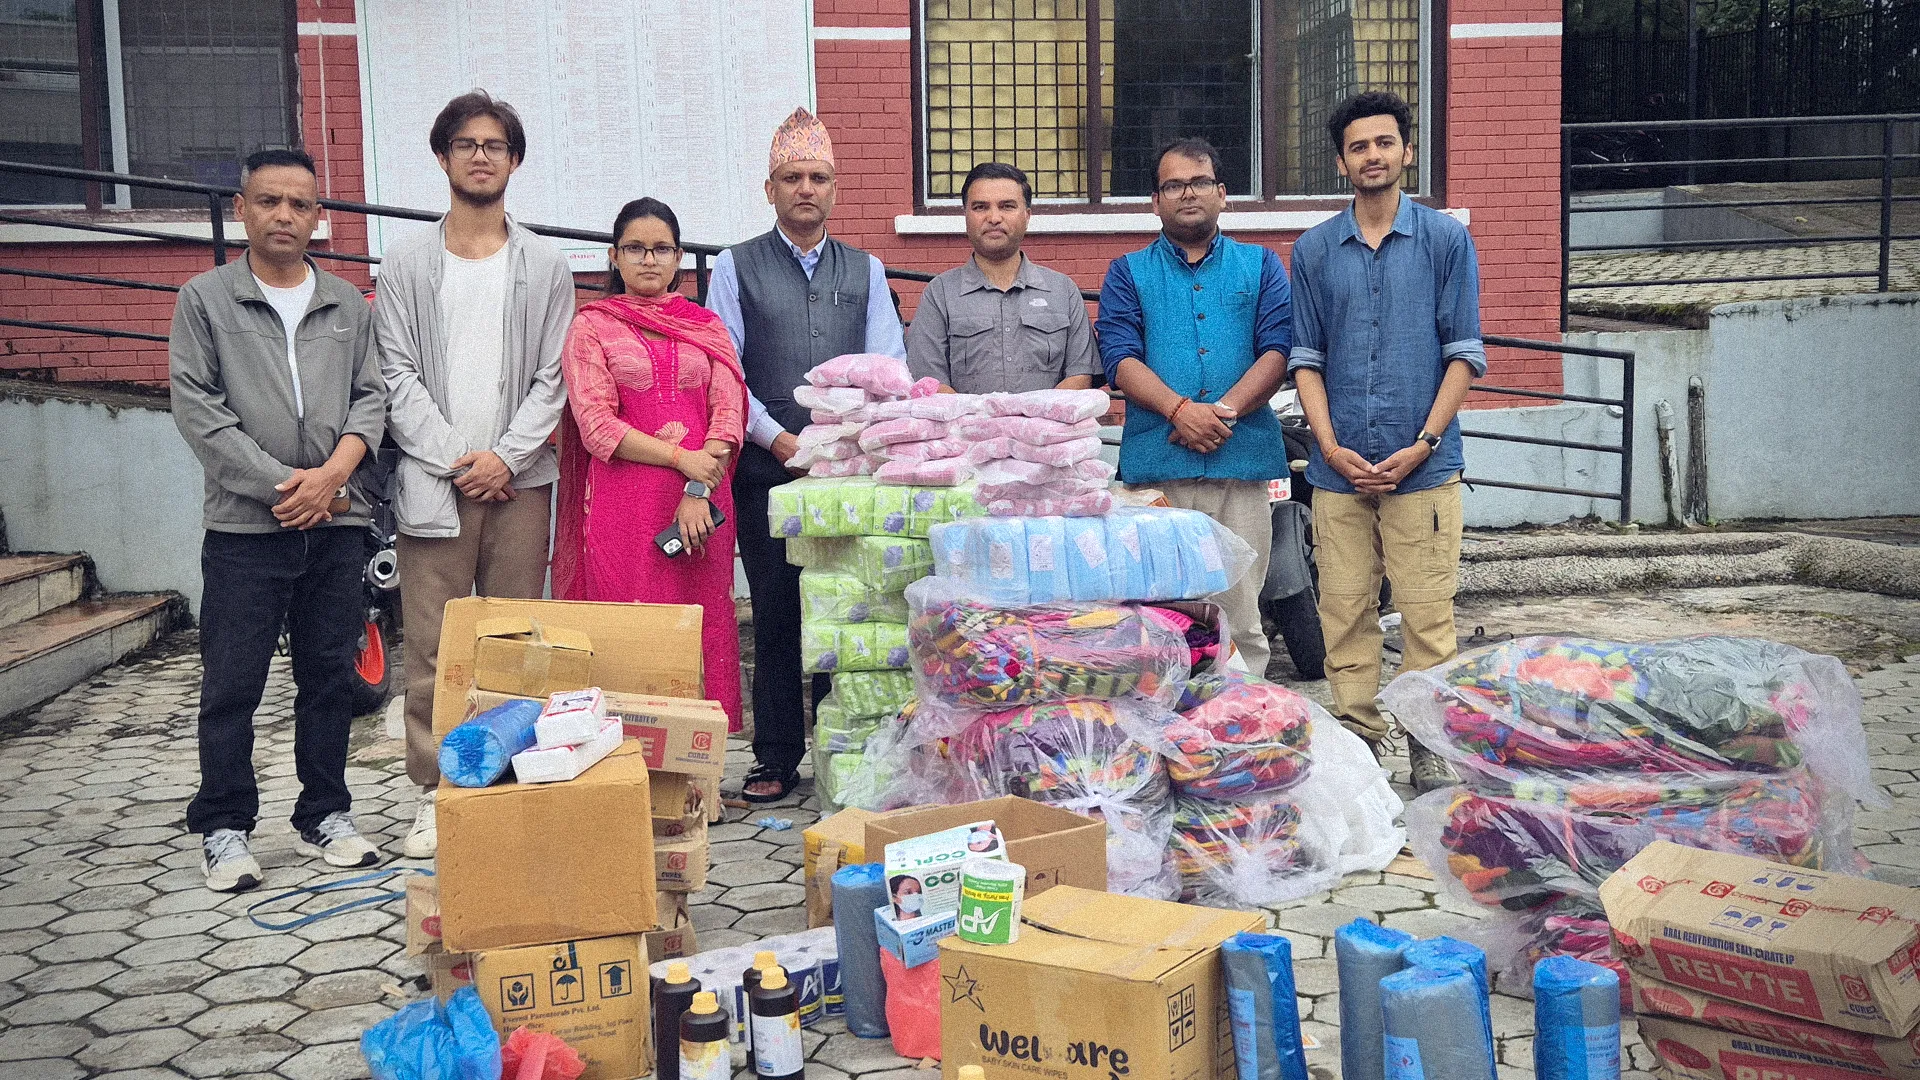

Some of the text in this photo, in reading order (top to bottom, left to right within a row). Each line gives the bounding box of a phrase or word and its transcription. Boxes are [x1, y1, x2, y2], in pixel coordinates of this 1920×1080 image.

[1664, 926, 1682, 940] ORAL
[1683, 931, 1735, 953] REHYDRATION
[610, 986, 622, 995] UP
[1667, 953, 1805, 1003] RELYTE
[1731, 1039, 1752, 1051] ORAL
[982, 1055, 1069, 1080] BABY SKIN CARE WIPES
